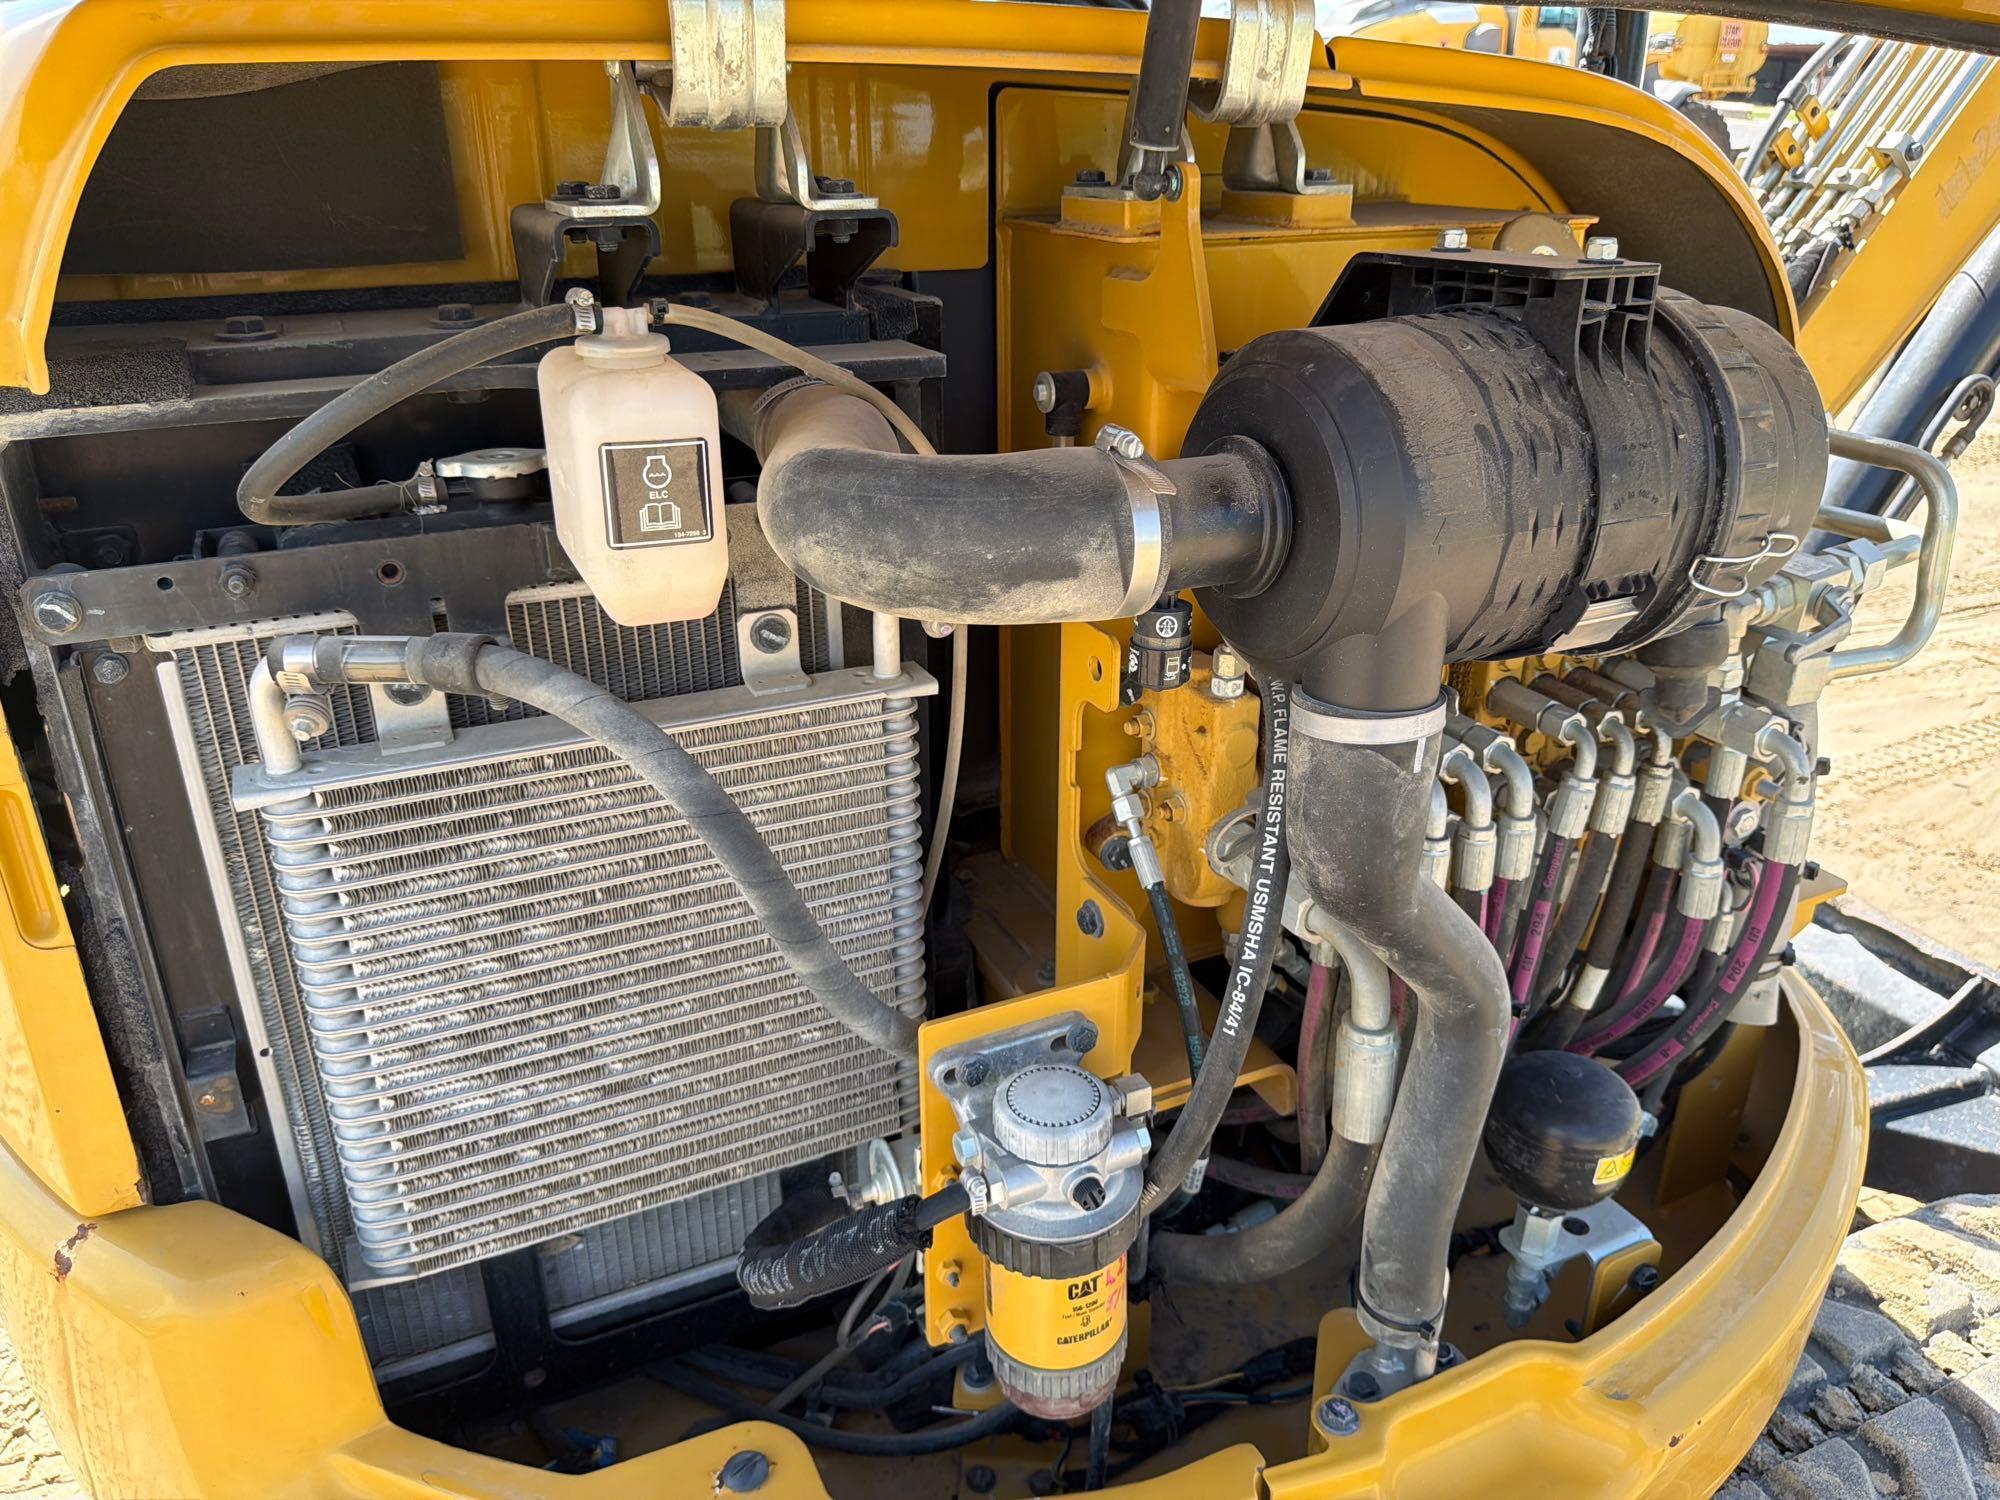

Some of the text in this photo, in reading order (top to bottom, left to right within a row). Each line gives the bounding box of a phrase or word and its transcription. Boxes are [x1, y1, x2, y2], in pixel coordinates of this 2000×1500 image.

[649, 490, 669, 500] ELC
[1272, 708, 1288, 765] FLAME
[1259, 768, 1287, 875] RESISTANT
[1241, 878, 1272, 960] USMSHA
[1222, 965, 1254, 1037] IC-84/41
[1067, 1275, 1101, 1301] CAT
[1056, 1320, 1110, 1346] CATERPILLAR
